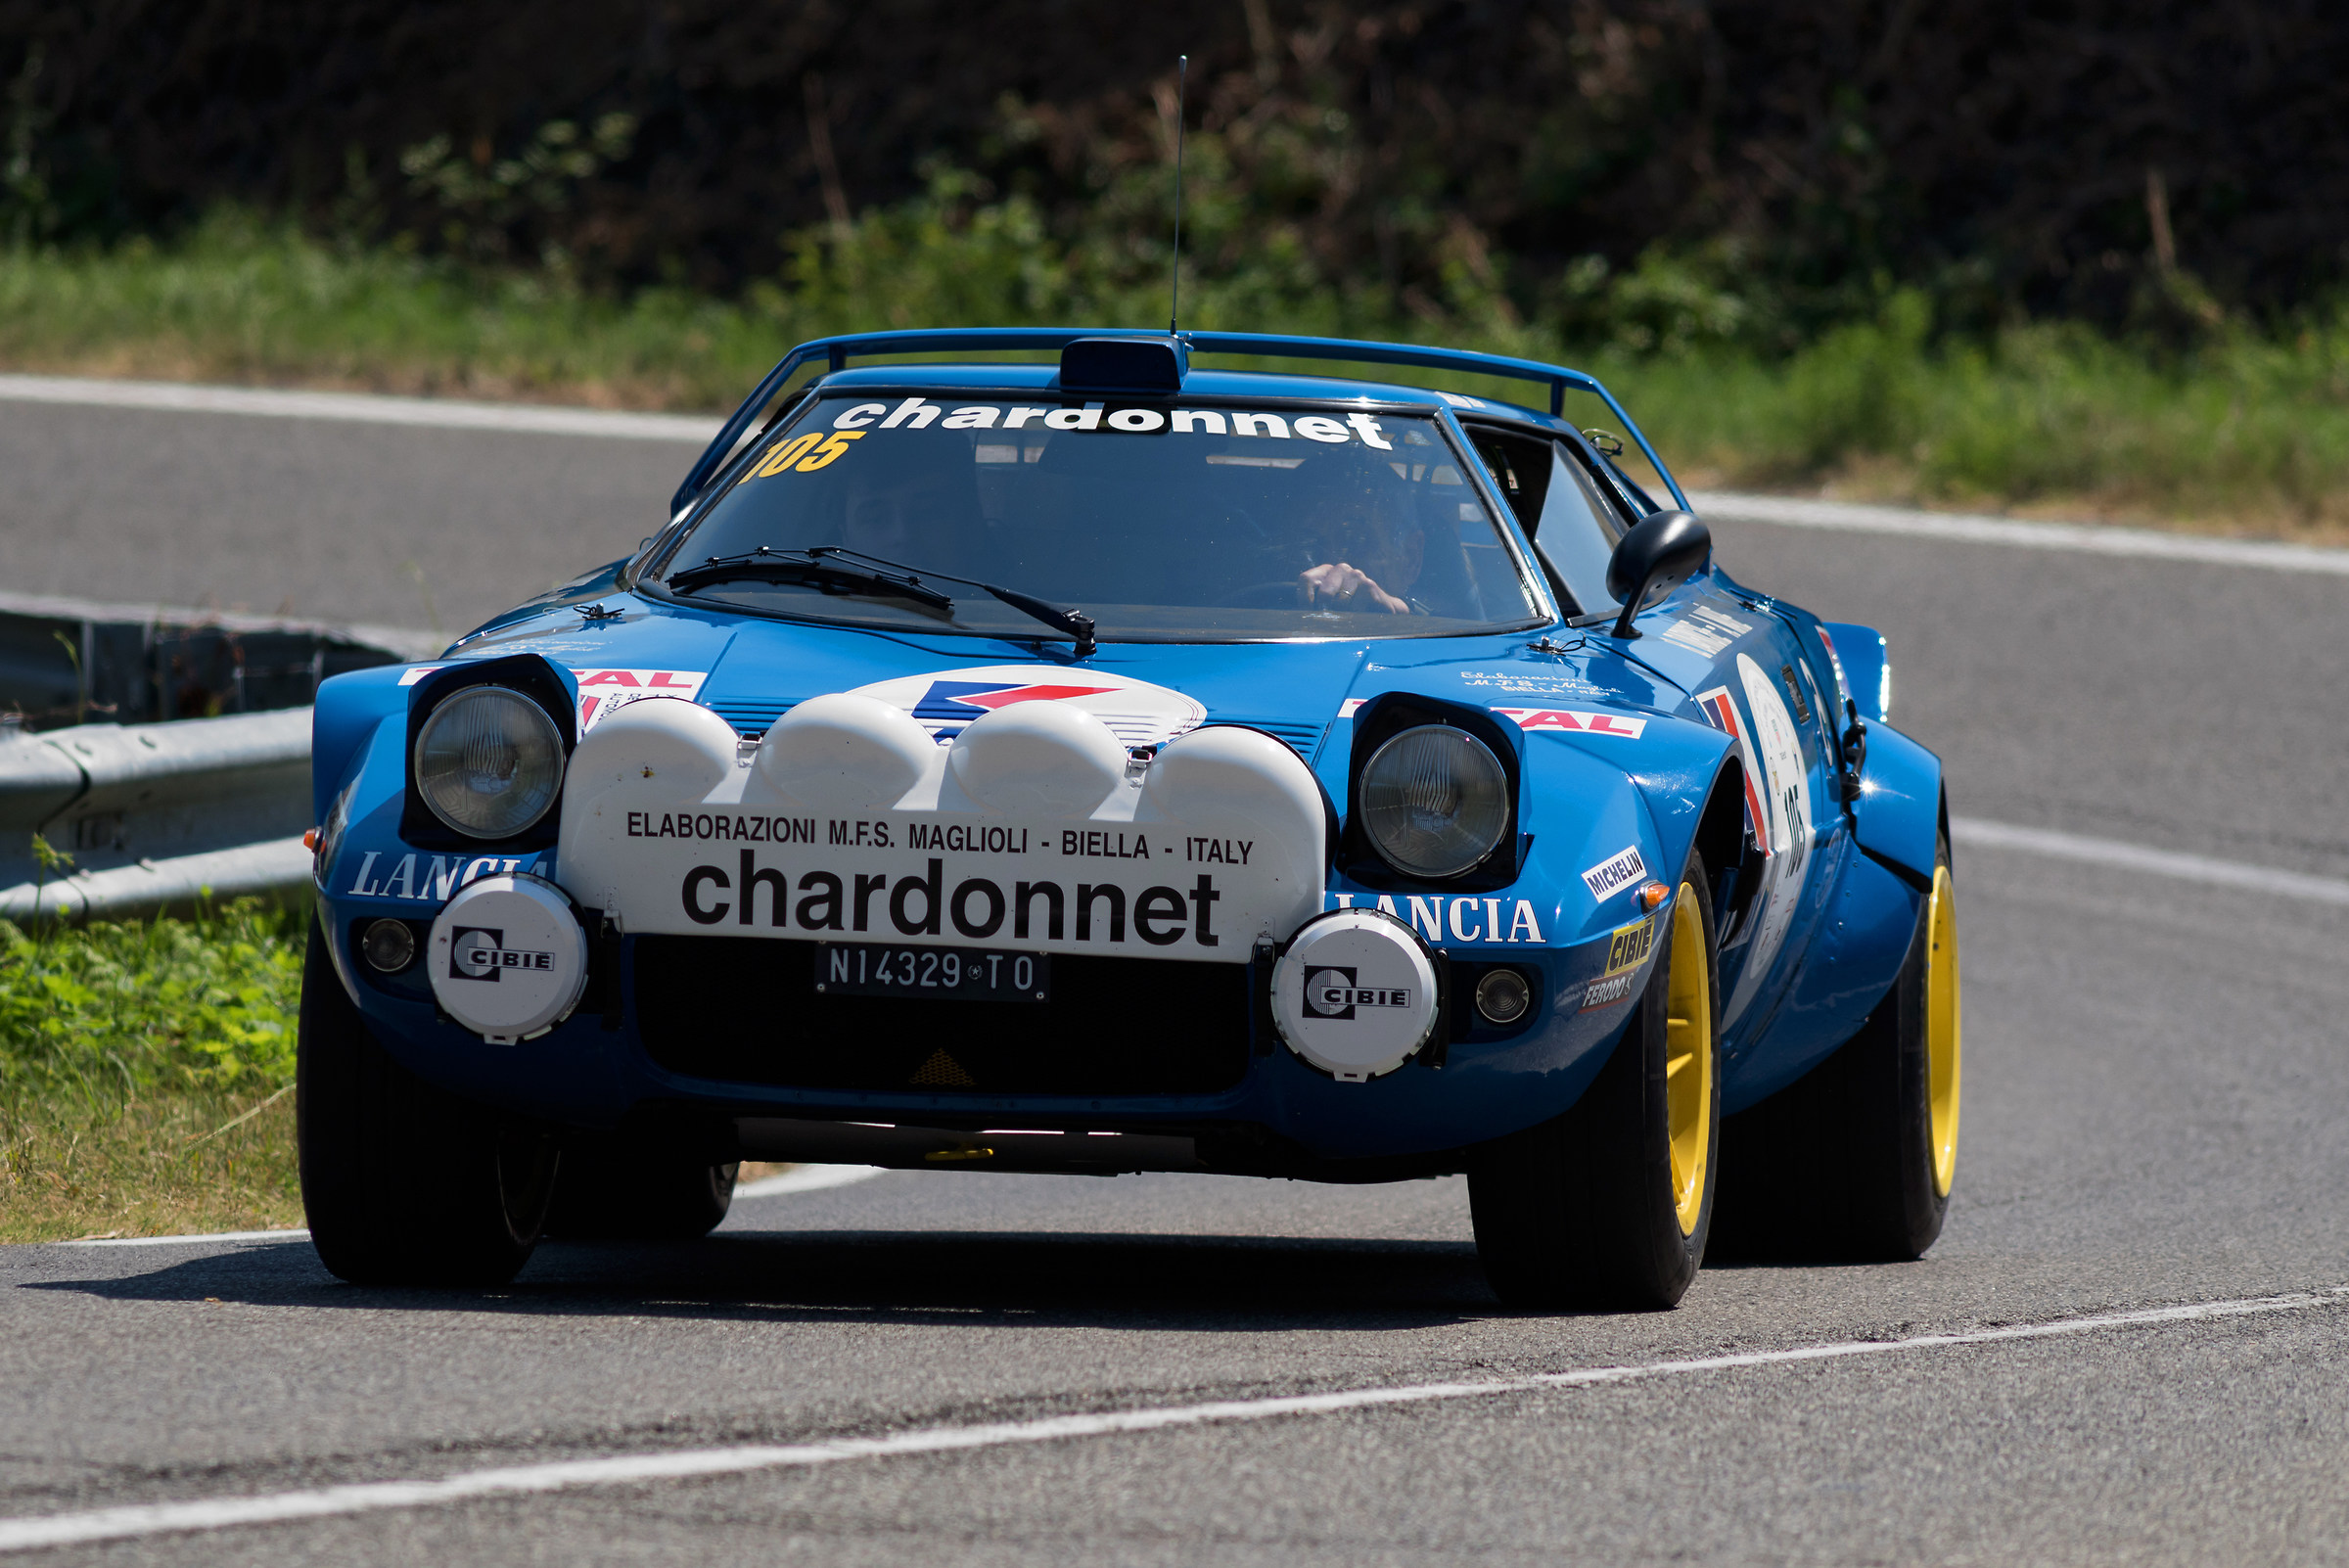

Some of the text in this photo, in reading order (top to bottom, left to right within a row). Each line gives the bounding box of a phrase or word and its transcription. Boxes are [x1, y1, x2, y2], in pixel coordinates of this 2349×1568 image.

[832, 396, 1393, 451] chardonnet
[737, 430, 867, 486] 105
[626, 810, 817, 845] ELABORAZIONI
[827, 818, 897, 850] M.F.S.
[907, 822, 1029, 854] MAGLIOLI
[1060, 828, 1151, 860] BIELLA
[1185, 835, 1255, 866] ITALY
[346, 850, 548, 902] LAN
[680, 847, 1221, 948] chardonnet
[1587, 851, 1644, 896] MICHELIN
[830, 947, 961, 989] N14329
[1582, 975, 1627, 1008] FERODO
